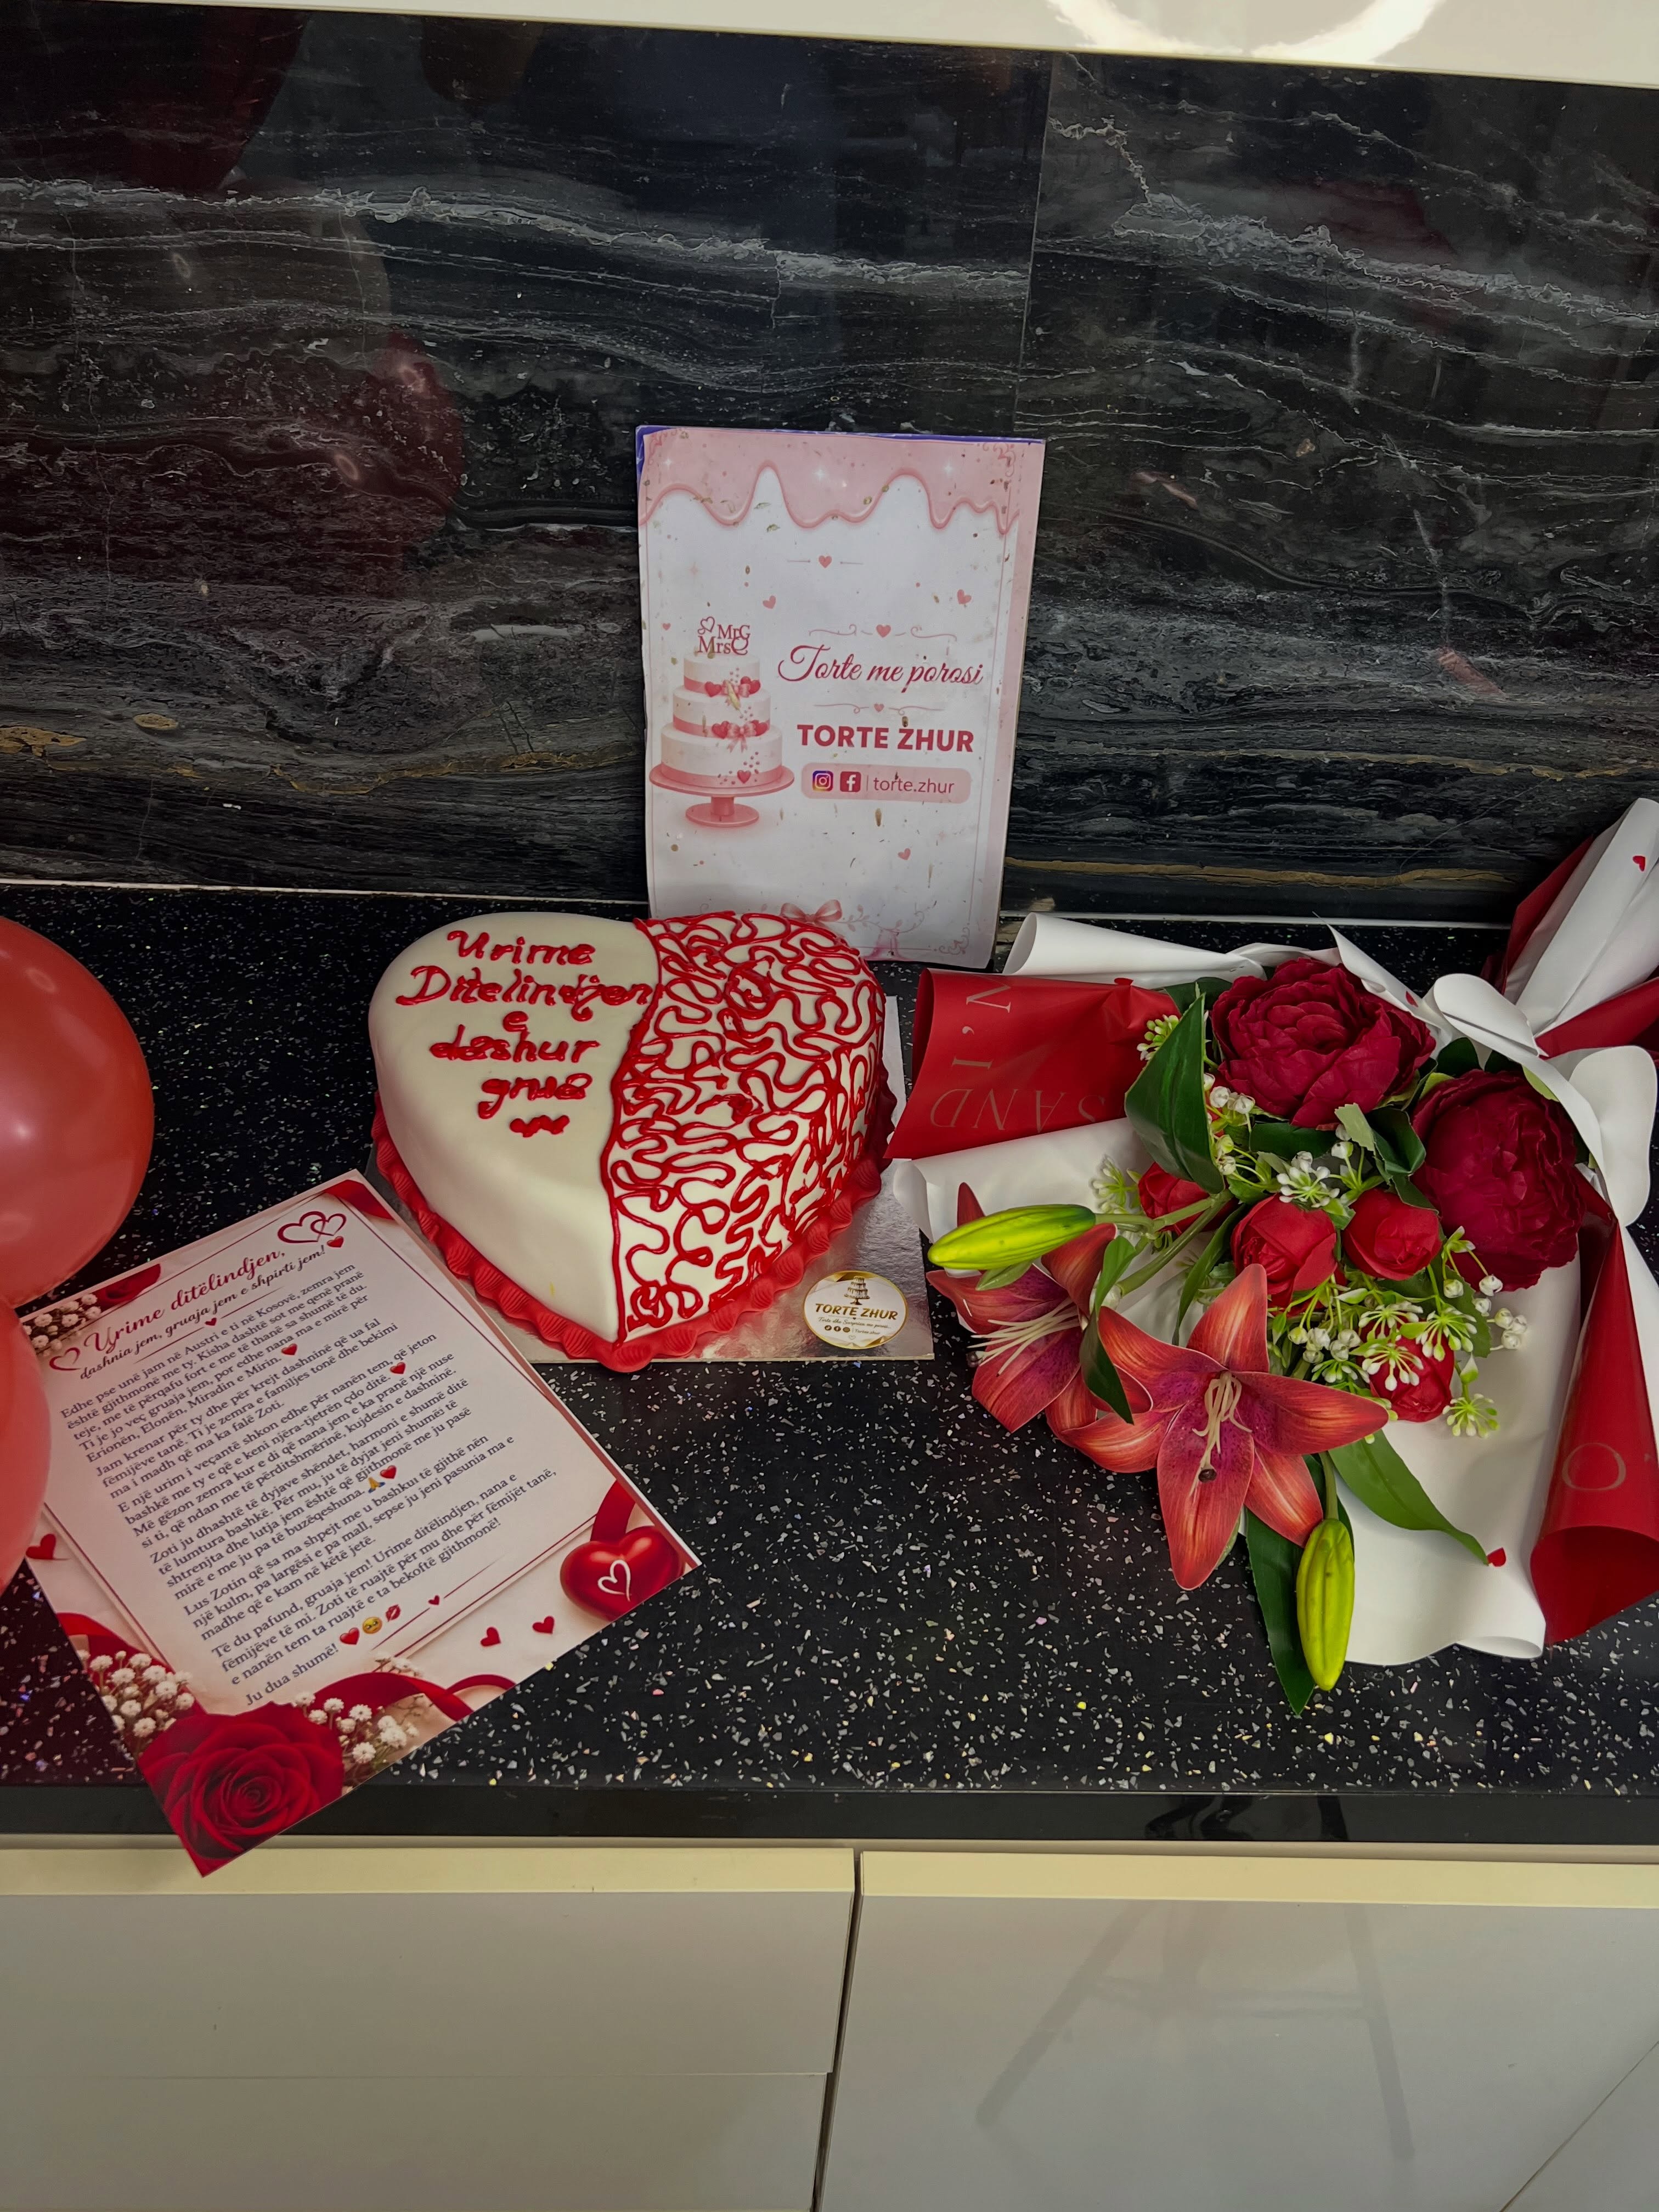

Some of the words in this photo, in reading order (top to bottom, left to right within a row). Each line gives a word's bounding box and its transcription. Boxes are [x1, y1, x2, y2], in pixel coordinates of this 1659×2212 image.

[778, 645, 862, 684] Torte
[867, 665, 904, 684] me
[901, 662, 984, 693] porosi
[797, 724, 889, 749] TORTE
[896, 728, 974, 753] ZHUR
[873, 776, 955, 794] torte.zhur
[447, 930, 596, 965] Urime
[429, 1024, 601, 1063] dashur
[503, 1011, 529, 1032] e
[60, 1399, 93, 1418] Edhe
[95, 1387, 116, 1403] pse
[117, 1373, 140, 1389] unë
[141, 1362, 166, 1379] jam
[166, 1351, 182, 1364] në
[185, 1331, 219, 1355] Austri
[229, 1322, 239, 1331] ti
[240, 1314, 256, 1325] në
[255, 1293, 300, 1317] Kosovë,
[300, 1276, 334, 1295] zemra
[333, 1265, 356, 1279] jem
[66, 1408, 99, 1429] është
[101, 1376, 160, 1414] gjithmonë
[161, 1367, 180, 1380] me
[181, 1359, 196, 1369] ty.
[196, 1341, 230, 1361] Kisha
[232, 1321, 268, 1343] dashtë
[269, 1312, 287, 1324] sot
[287, 1302, 305, 1314] me
[306, 1287, 332, 1305] qenë
[332, 1271, 364, 1293] pranë
[80, 1347, 133, 1380] dashnia
[132, 1333, 163, 1358] jem,
[165, 1305, 211, 1338] gruaja
[211, 1293, 238, 1316] jem
[252, 1262, 296, 1293] shpirti
[295, 1245, 325, 1273] jem!
[84, 1307, 163, 1353] Urime
[171, 1250, 285, 1311] ditëlindjen,
[815, 1303, 859, 1316] TORTE
[860, 1308, 898, 1320] ZHUR
[73, 1425, 101, 1440] teje,
[101, 1412, 121, 1426] me
[122, 1403, 136, 1414] të
[137, 1379, 184, 1409] përqafu
[184, 1366, 208, 1381] fort
[217, 1351, 236, 1364] me
[237, 1342, 250, 1353] të
[250, 1325, 283, 1346] thanë
[284, 1319, 298, 1329] sa
[298, 1299, 335, 1322] shumë
[335, 1292, 348, 1301] të
[348, 1284, 367, 1295] du.
[85, 1434, 140, 1463] Erionën,
[139, 1408, 188, 1434] Elonën,
[186, 1380, 235, 1409] Miradin
[244, 1357, 282, 1378] Mirin.
[102, 1456, 155, 1487] fëmijëve
[156, 1438, 188, 1458] tanë.
[187, 1427, 204, 1440] Ti
[204, 1423, 217, 1435] je
[217, 1402, 255, 1425] zemra
[264, 1372, 310, 1399] familjes
[309, 1355, 337, 1374] tonë
[337, 1345, 359, 1359] dhe
[357, 1322, 398, 1347] bekimi
[109, 1485, 131, 1499] ma
[131, 1478, 138, 1487] i
[140, 1459, 176, 1482] madh
[177, 1448, 193, 1462] që
[194, 1438, 215, 1453] ma
[213, 1430, 232, 1441] ka
[232, 1414, 255, 1431] falë
[254, 1400, 285, 1419] Zoti.
[124, 1496, 170, 1525] bashkë
[171, 1486, 191, 1500] me
[191, 1477, 205, 1488] ty
[217, 1461, 233, 1475] që
[241, 1440, 270, 1460] keni
[270, 1402, 343, 1444] njëra-tjetrën
[343, 1389, 364, 1404] çdo
[365, 1374, 391, 1391] ditë.
[141, 1536, 153, 1548] si
[154, 1530, 169, 1541] ti,
[170, 1519, 185, 1533] që
[187, 1502, 219, 1523] ndan
[220, 1490, 240, 1505] me
[240, 1480, 255, 1492] të
[344, 1403, 394, 1433] kujdesin
[404, 1367, 456, 1400] dashninë.
[149, 1543, 179, 1564] Zoti
[179, 1536, 194, 1550] ju
[195, 1506, 244, 1539] dhashtë
[245, 1498, 259, 1510] të
[260, 1477, 299, 1502] dyjave
[300, 1449, 351, 1480] shëndet,
[348, 1418, 399, 1451] harmoni
[408, 1391, 446, 1417] shumë
[447, 1378, 469, 1395] ditë
[174, 1577, 205, 1600] mirë
[206, 1573, 216, 1581] e
[216, 1560, 238, 1576] me
[237, 1551, 253, 1566] ju
[253, 1542, 271, 1557] pa
[270, 1532, 285, 1544] të
[200, 1611, 245, 1641] madhe
[247, 1599, 263, 1614] që
[264, 1595, 273, 1603] e
[272, 1578, 303, 1598] kam
[303, 1565, 320, 1581] në
[319, 1549, 348, 1570] këtë
[348, 1535, 376, 1557] jetë.
[211, 1642, 231, 1657] Të
[233, 1632, 252, 1646] du
[252, 1601, 303, 1638] pafund,
[304, 1578, 345, 1607] gruaja
[343, 1558, 373, 1584] jem!
[371, 1537, 413, 1562] Urime
[478, 1480, 509, 1500] nana
[245, 1691, 263, 1706] Ju
[264, 1675, 291, 1694] dua
[291, 1643, 338, 1678] shumë!
